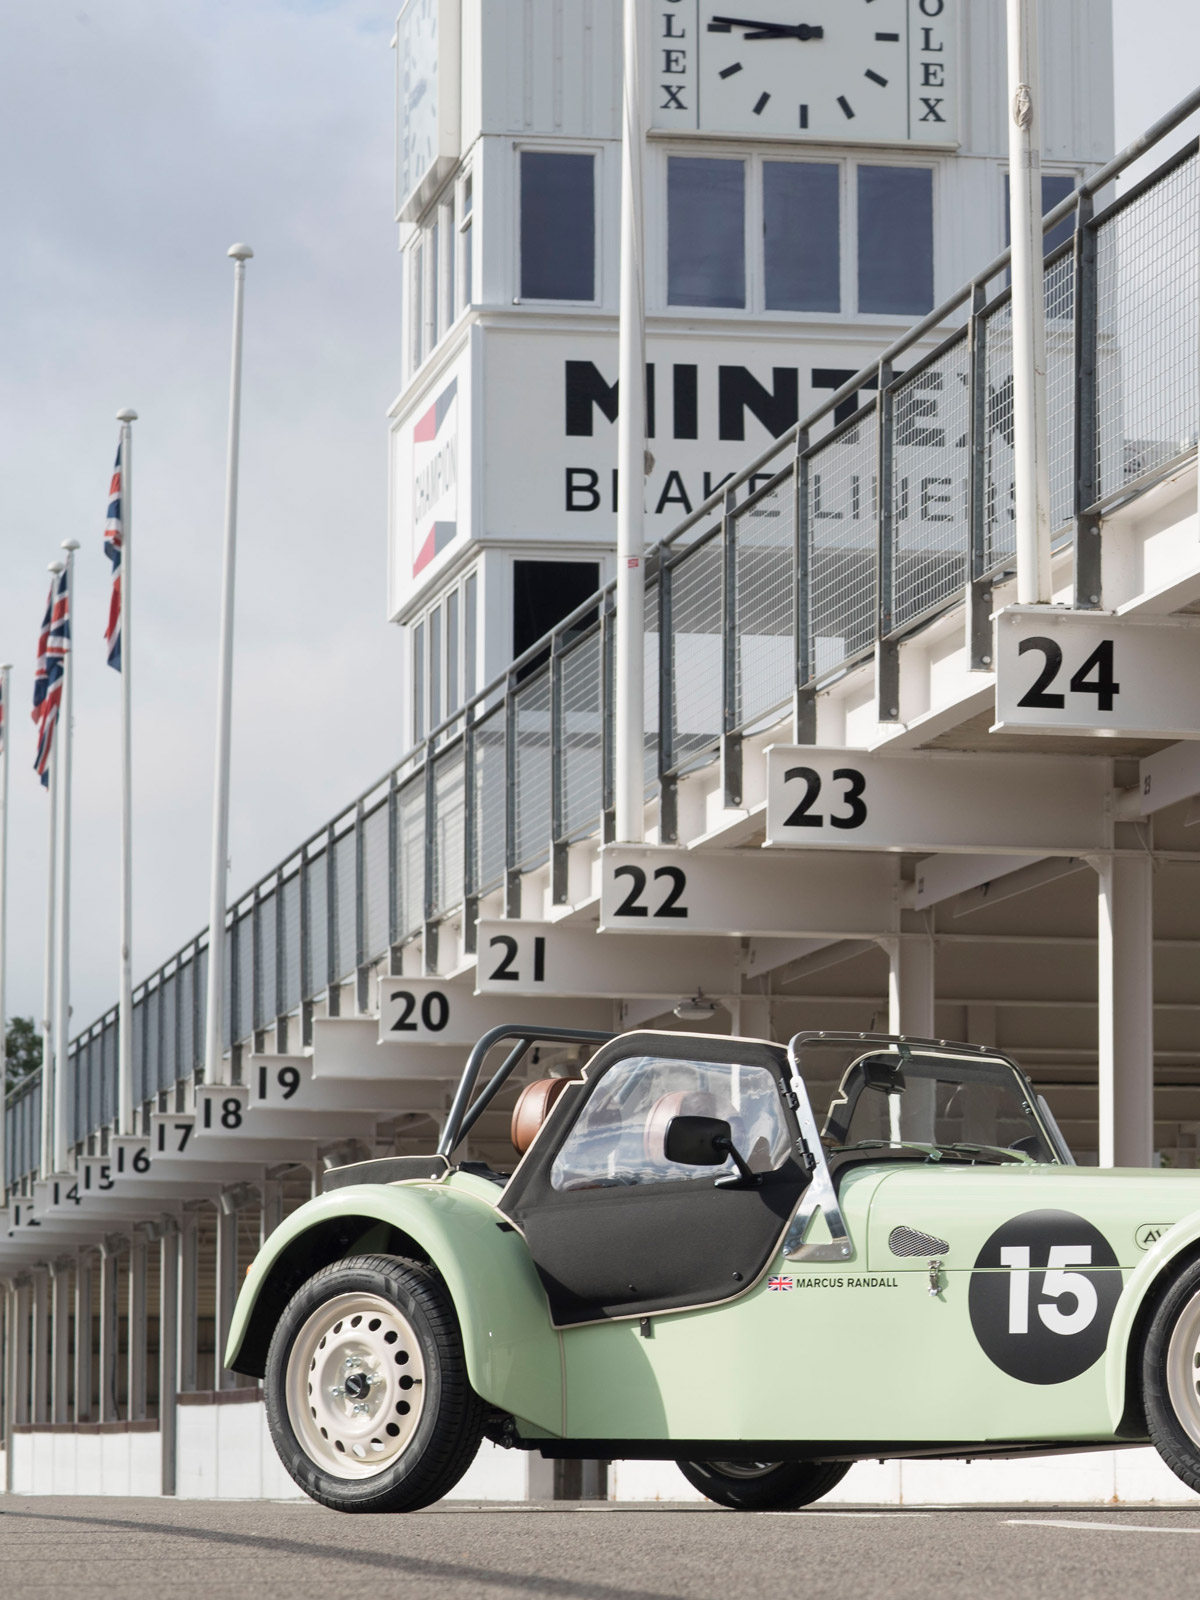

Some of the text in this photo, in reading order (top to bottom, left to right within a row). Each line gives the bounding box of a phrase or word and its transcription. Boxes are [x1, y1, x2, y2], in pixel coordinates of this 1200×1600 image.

[660, 0, 688, 110] LEX
[565, 467, 1015, 524] BAKE LINE
[1017, 636, 1120, 711] 24
[783, 766, 868, 829] 23
[613, 865, 688, 918] 22
[489, 935, 546, 982] 21
[390, 990, 450, 1032] 20
[258, 1066, 300, 1100] 19
[203, 1097, 243, 1130] 18
[158, 1123, 194, 1153] 17
[84, 1165, 115, 1191] 15
[117, 1146, 151, 1174] 16
[53, 1182, 82, 1206] 14
[796, 1277, 899, 1288] MARCUS RANDALL
[1000, 1245, 1098, 1336] 15
